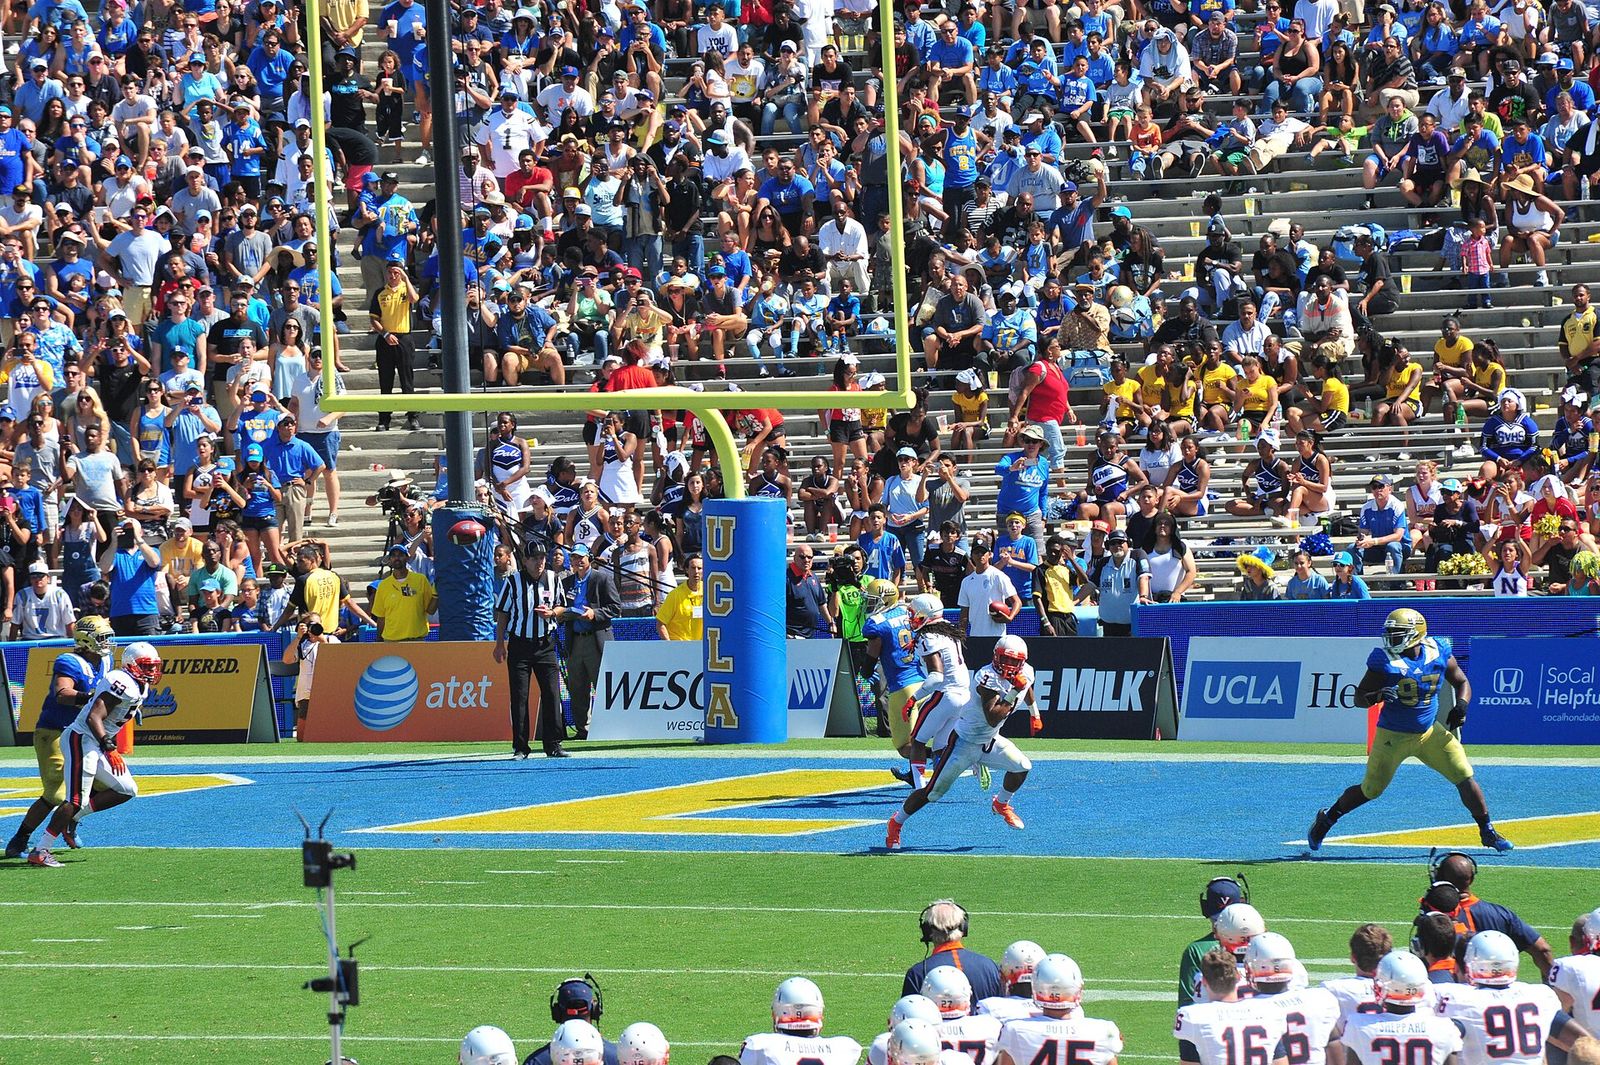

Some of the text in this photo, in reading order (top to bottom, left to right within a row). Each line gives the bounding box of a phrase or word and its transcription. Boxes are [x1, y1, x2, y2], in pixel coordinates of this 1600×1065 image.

[709, 37, 725, 46] YOU
[503, 128, 512, 150] 1
[223, 329, 253, 337] BEAST
[997, 329, 1015, 348] 17
[1498, 431, 1525, 445] SVHS
[1501, 577, 1518, 595] N
[846, 591, 859, 602] FO
[36, 607, 50, 634] 7
[705, 515, 739, 730] UCLA
[980, 674, 989, 685] 3
[1547, 667, 1595, 684] SoCal
[111, 680, 126, 696] 53
[425, 675, 493, 709] at&t
[1203, 673, 1357, 708] UCLA He
[1397, 673, 1441, 707] 97
[1479, 697, 1533, 705] HONDA
[1549, 966, 1559, 983] 3
[1285, 1012, 1311, 1064] 6
[1484, 1003, 1542, 1058] 96
[1221, 1025, 1269, 1065] 16
